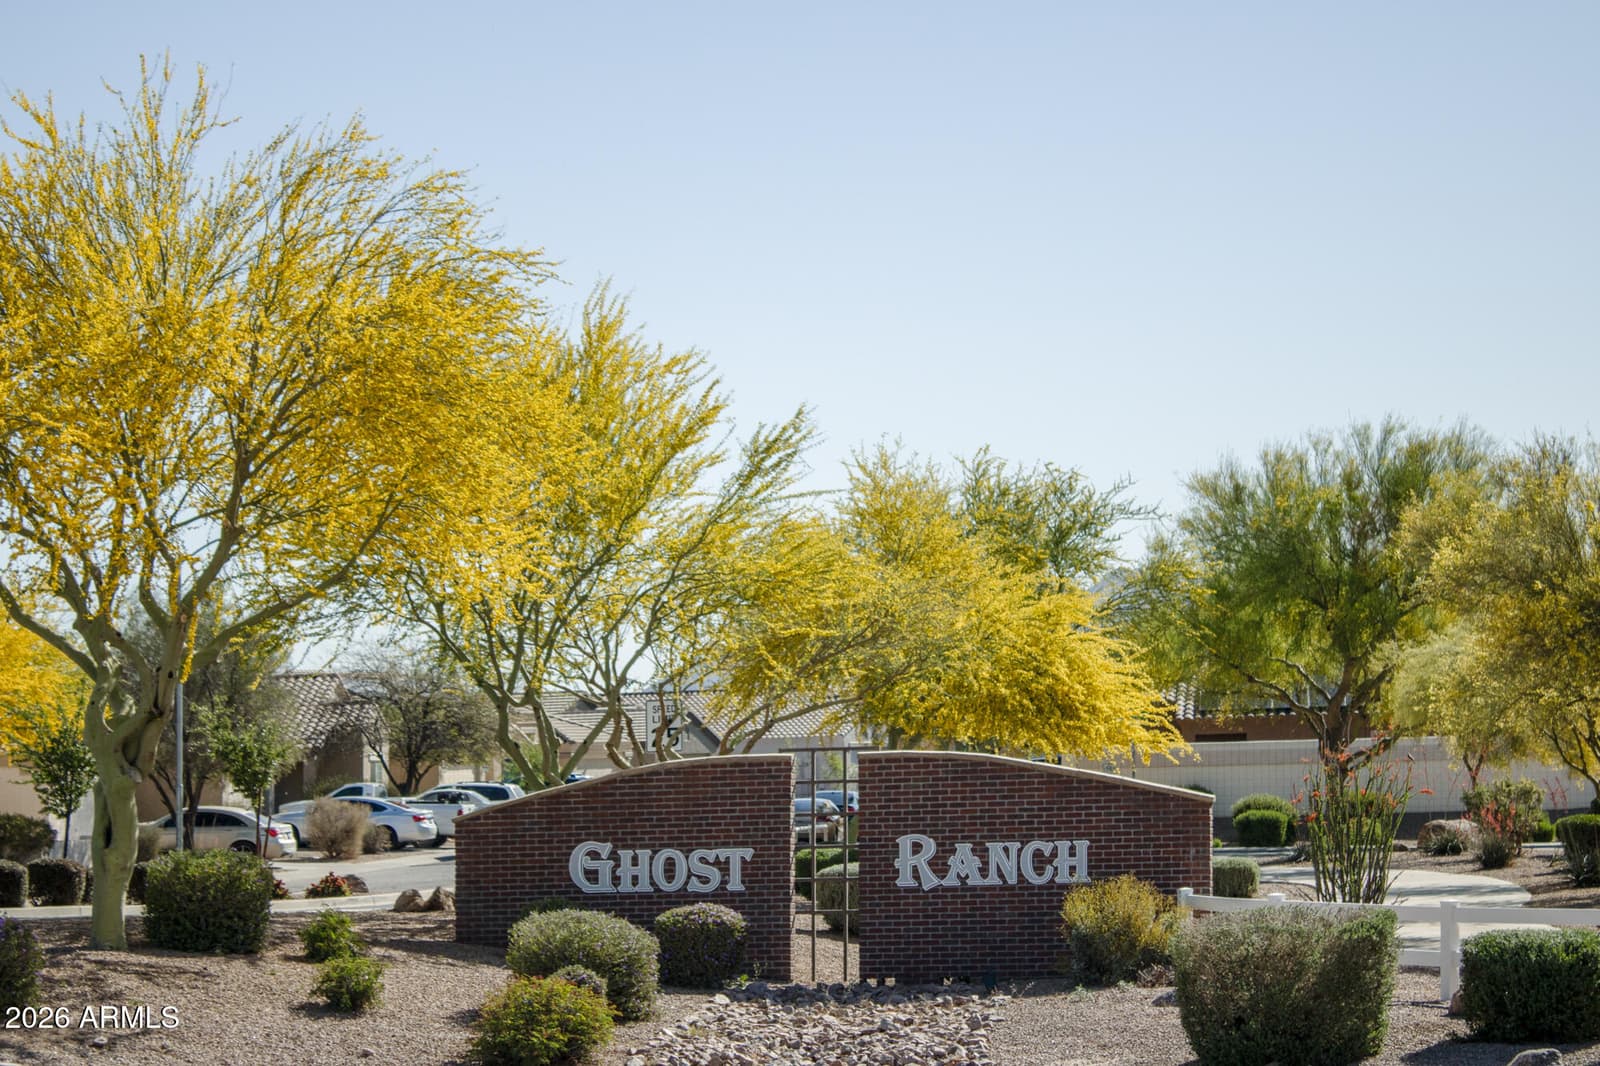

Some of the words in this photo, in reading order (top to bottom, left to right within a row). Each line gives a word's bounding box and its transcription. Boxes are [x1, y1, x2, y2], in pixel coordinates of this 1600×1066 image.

[652, 705, 676, 714] SPED
[569, 841, 755, 893] GHOST
[894, 834, 1091, 891] RANCH
